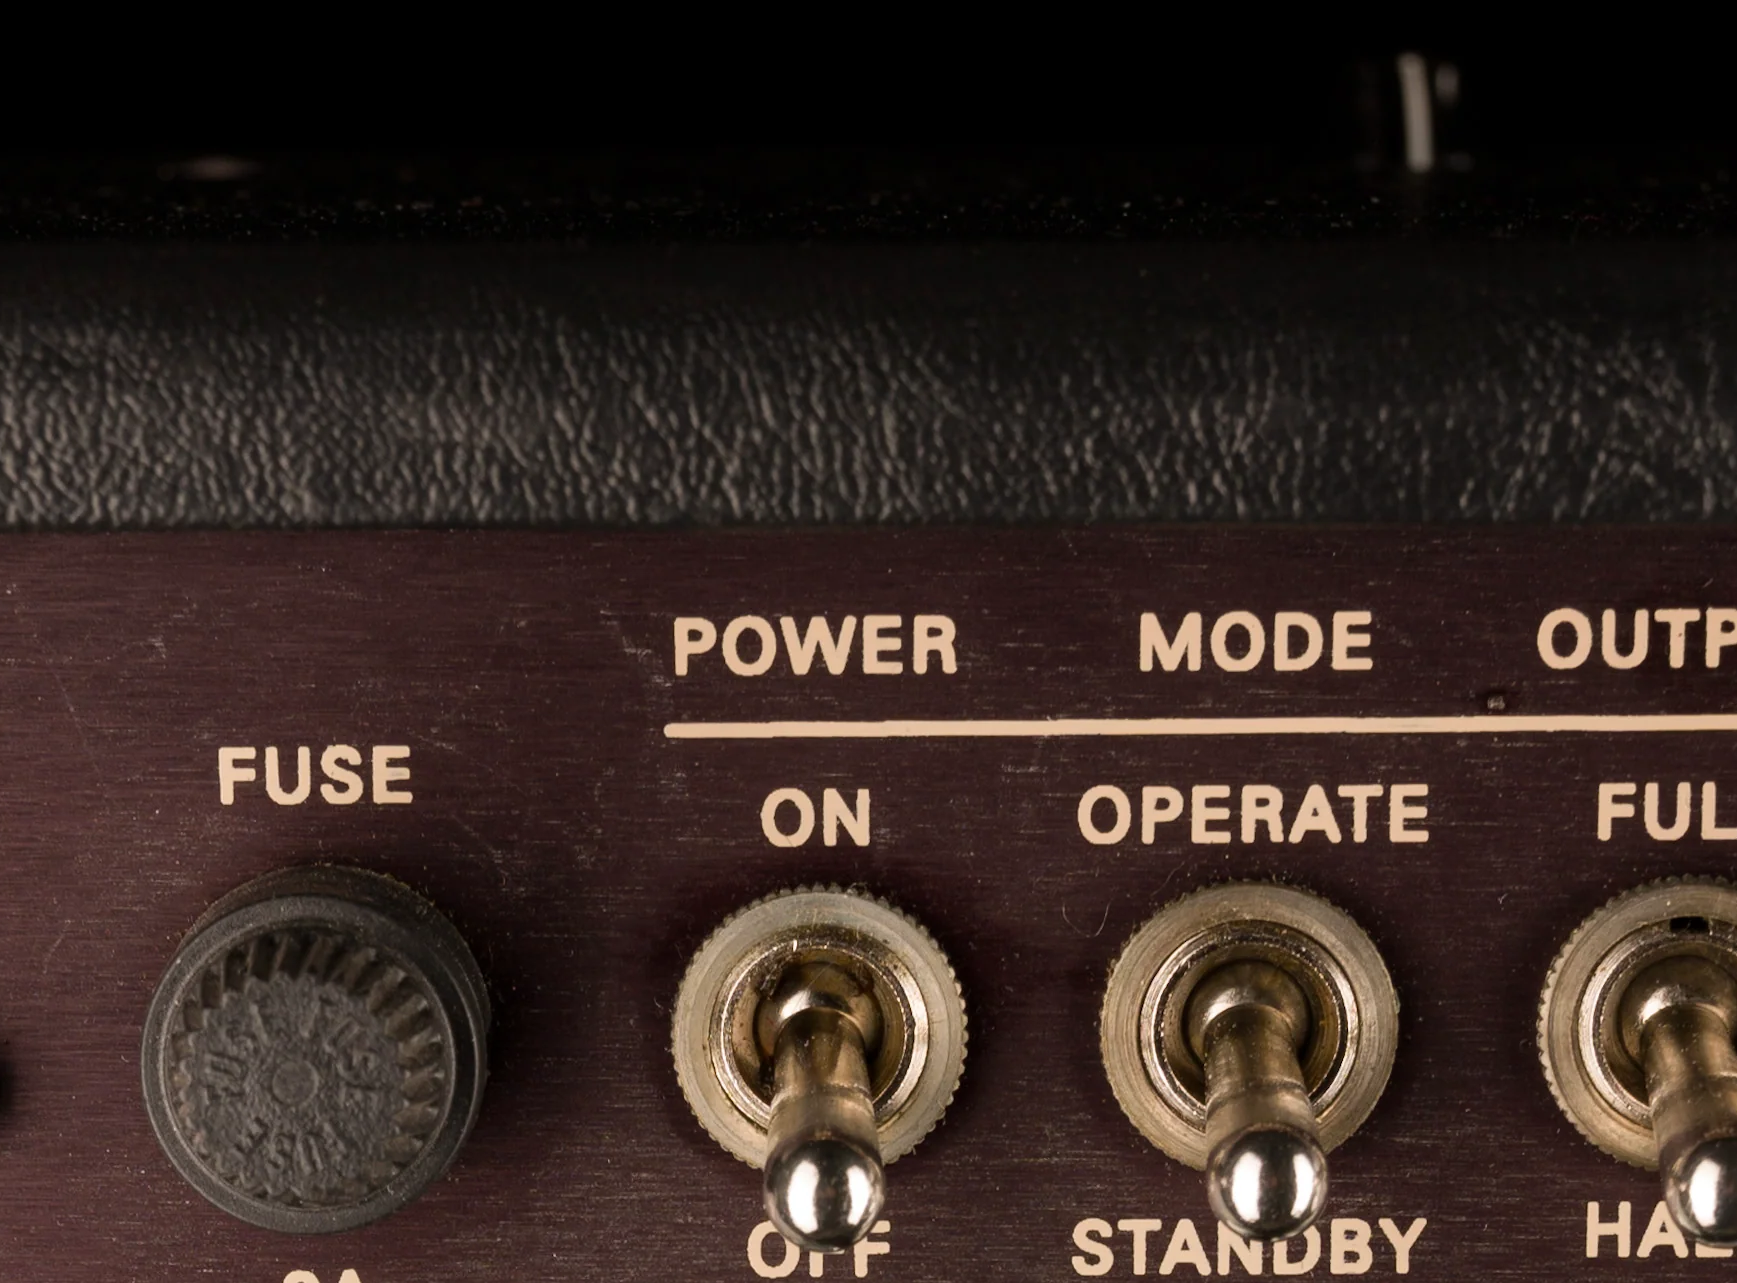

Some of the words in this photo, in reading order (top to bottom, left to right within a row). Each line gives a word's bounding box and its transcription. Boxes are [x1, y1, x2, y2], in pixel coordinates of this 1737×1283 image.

[674, 615, 957, 676] POWER
[1140, 611, 1373, 671] MODE
[219, 745, 412, 805] FUSE
[760, 788, 870, 847] ON
[1078, 784, 1429, 844] OPERATE
[1071, 1217, 1428, 1276] STANDBY
